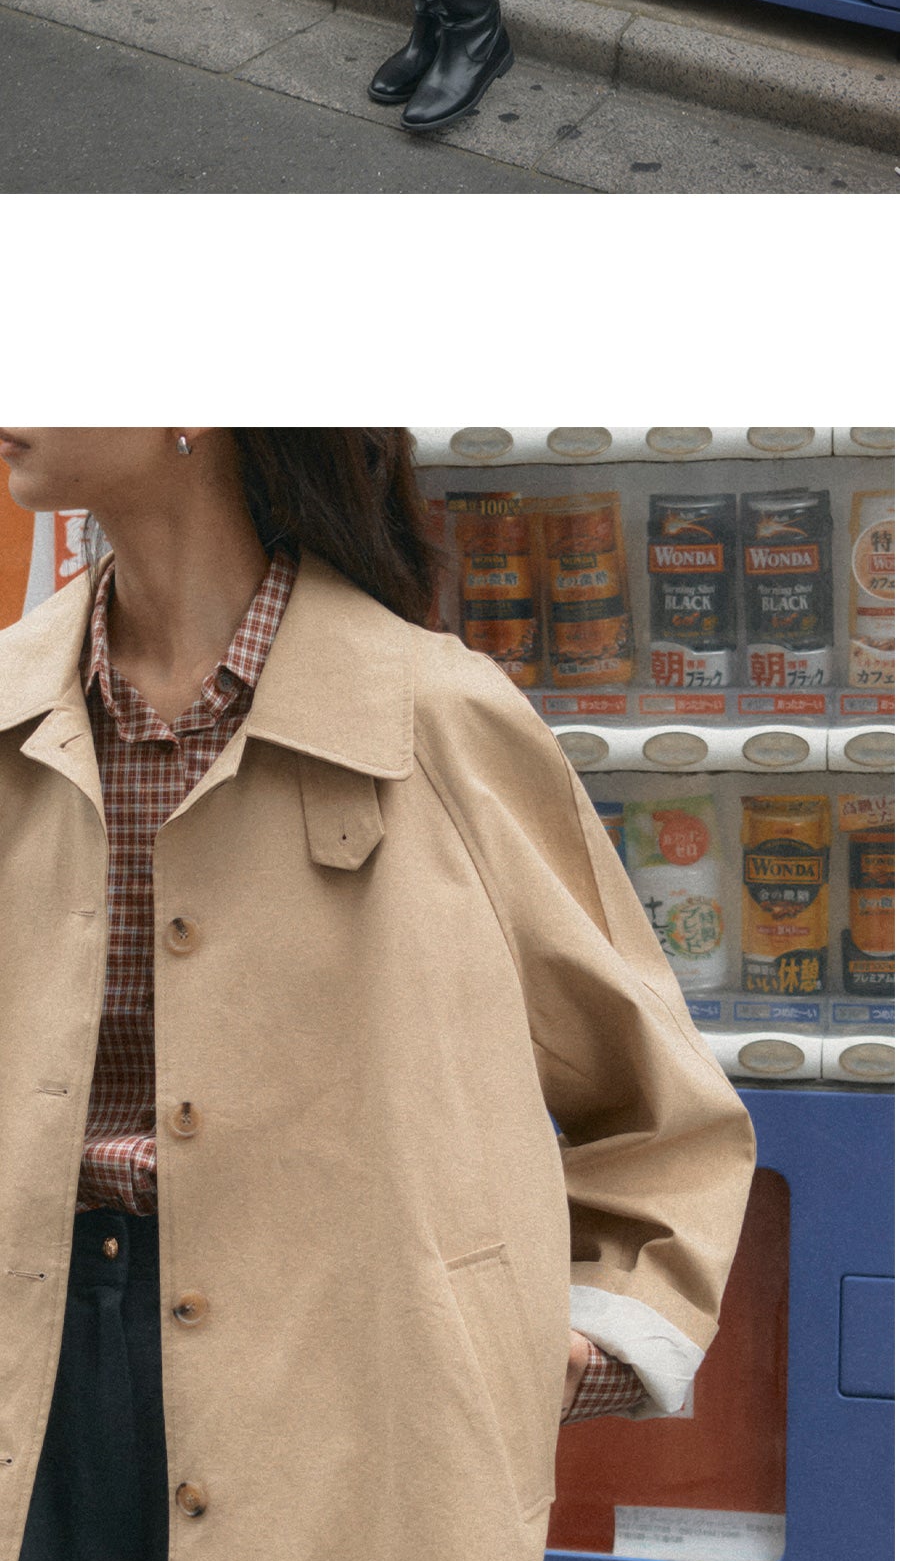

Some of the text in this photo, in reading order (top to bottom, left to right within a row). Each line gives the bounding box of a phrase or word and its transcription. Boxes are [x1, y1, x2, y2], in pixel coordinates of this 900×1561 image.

[655, 546, 716, 567] WONDA
[750, 548, 812, 568] WONDA
[664, 595, 712, 611] BLACK
[761, 596, 808, 612] BLACK
[651, 650, 685, 687] 朝
[751, 652, 785, 688] 朝
[788, 668, 824, 687] ブラック
[857, 670, 895, 684] カフェ
[686, 671, 723, 687] ブラック
[750, 858, 816, 877] WONDA
[778, 957, 819, 994] 休憩
